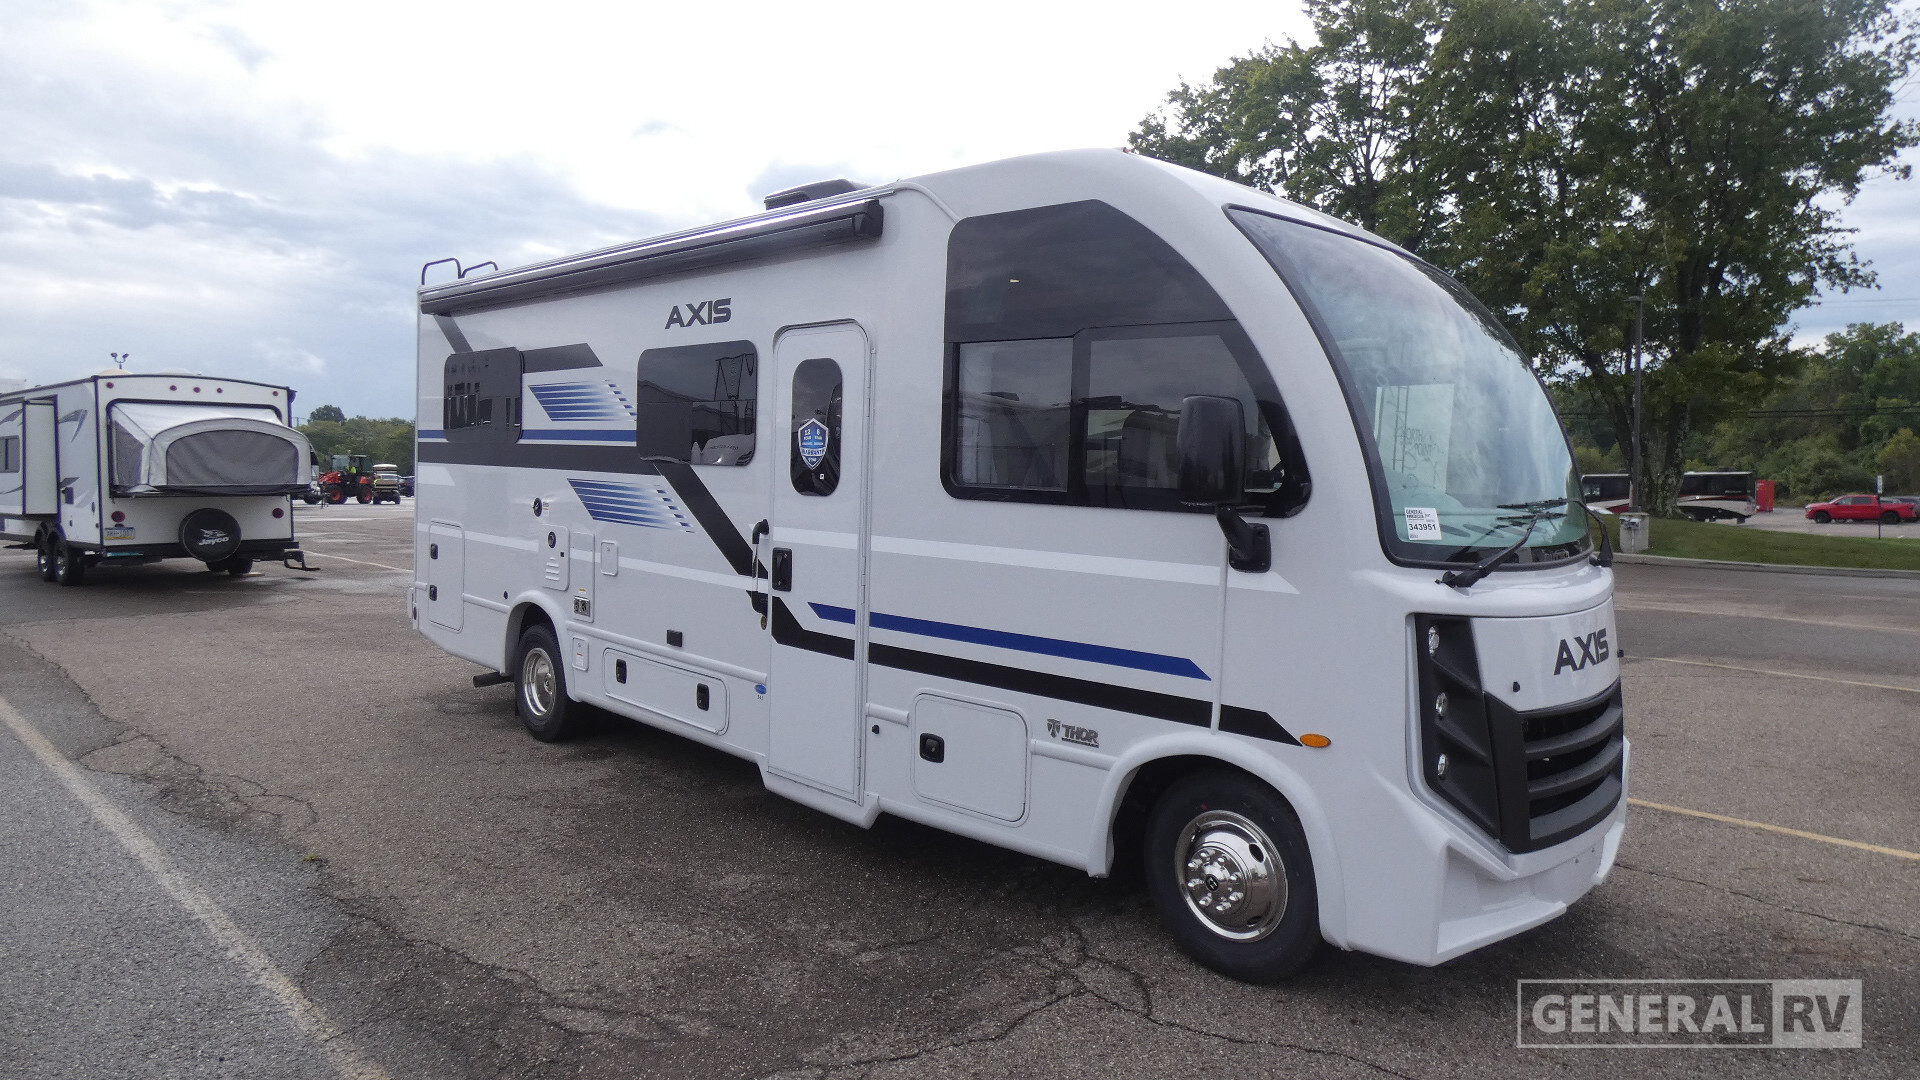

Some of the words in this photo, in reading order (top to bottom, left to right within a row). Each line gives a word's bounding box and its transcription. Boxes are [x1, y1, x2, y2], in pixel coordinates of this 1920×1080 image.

[665, 298, 731, 329] AXIS
[1409, 523, 1437, 531] 343951
[198, 536, 230, 546] Jayco
[1554, 628, 1609, 675] AXIS
[1061, 724, 1099, 745] THOR
